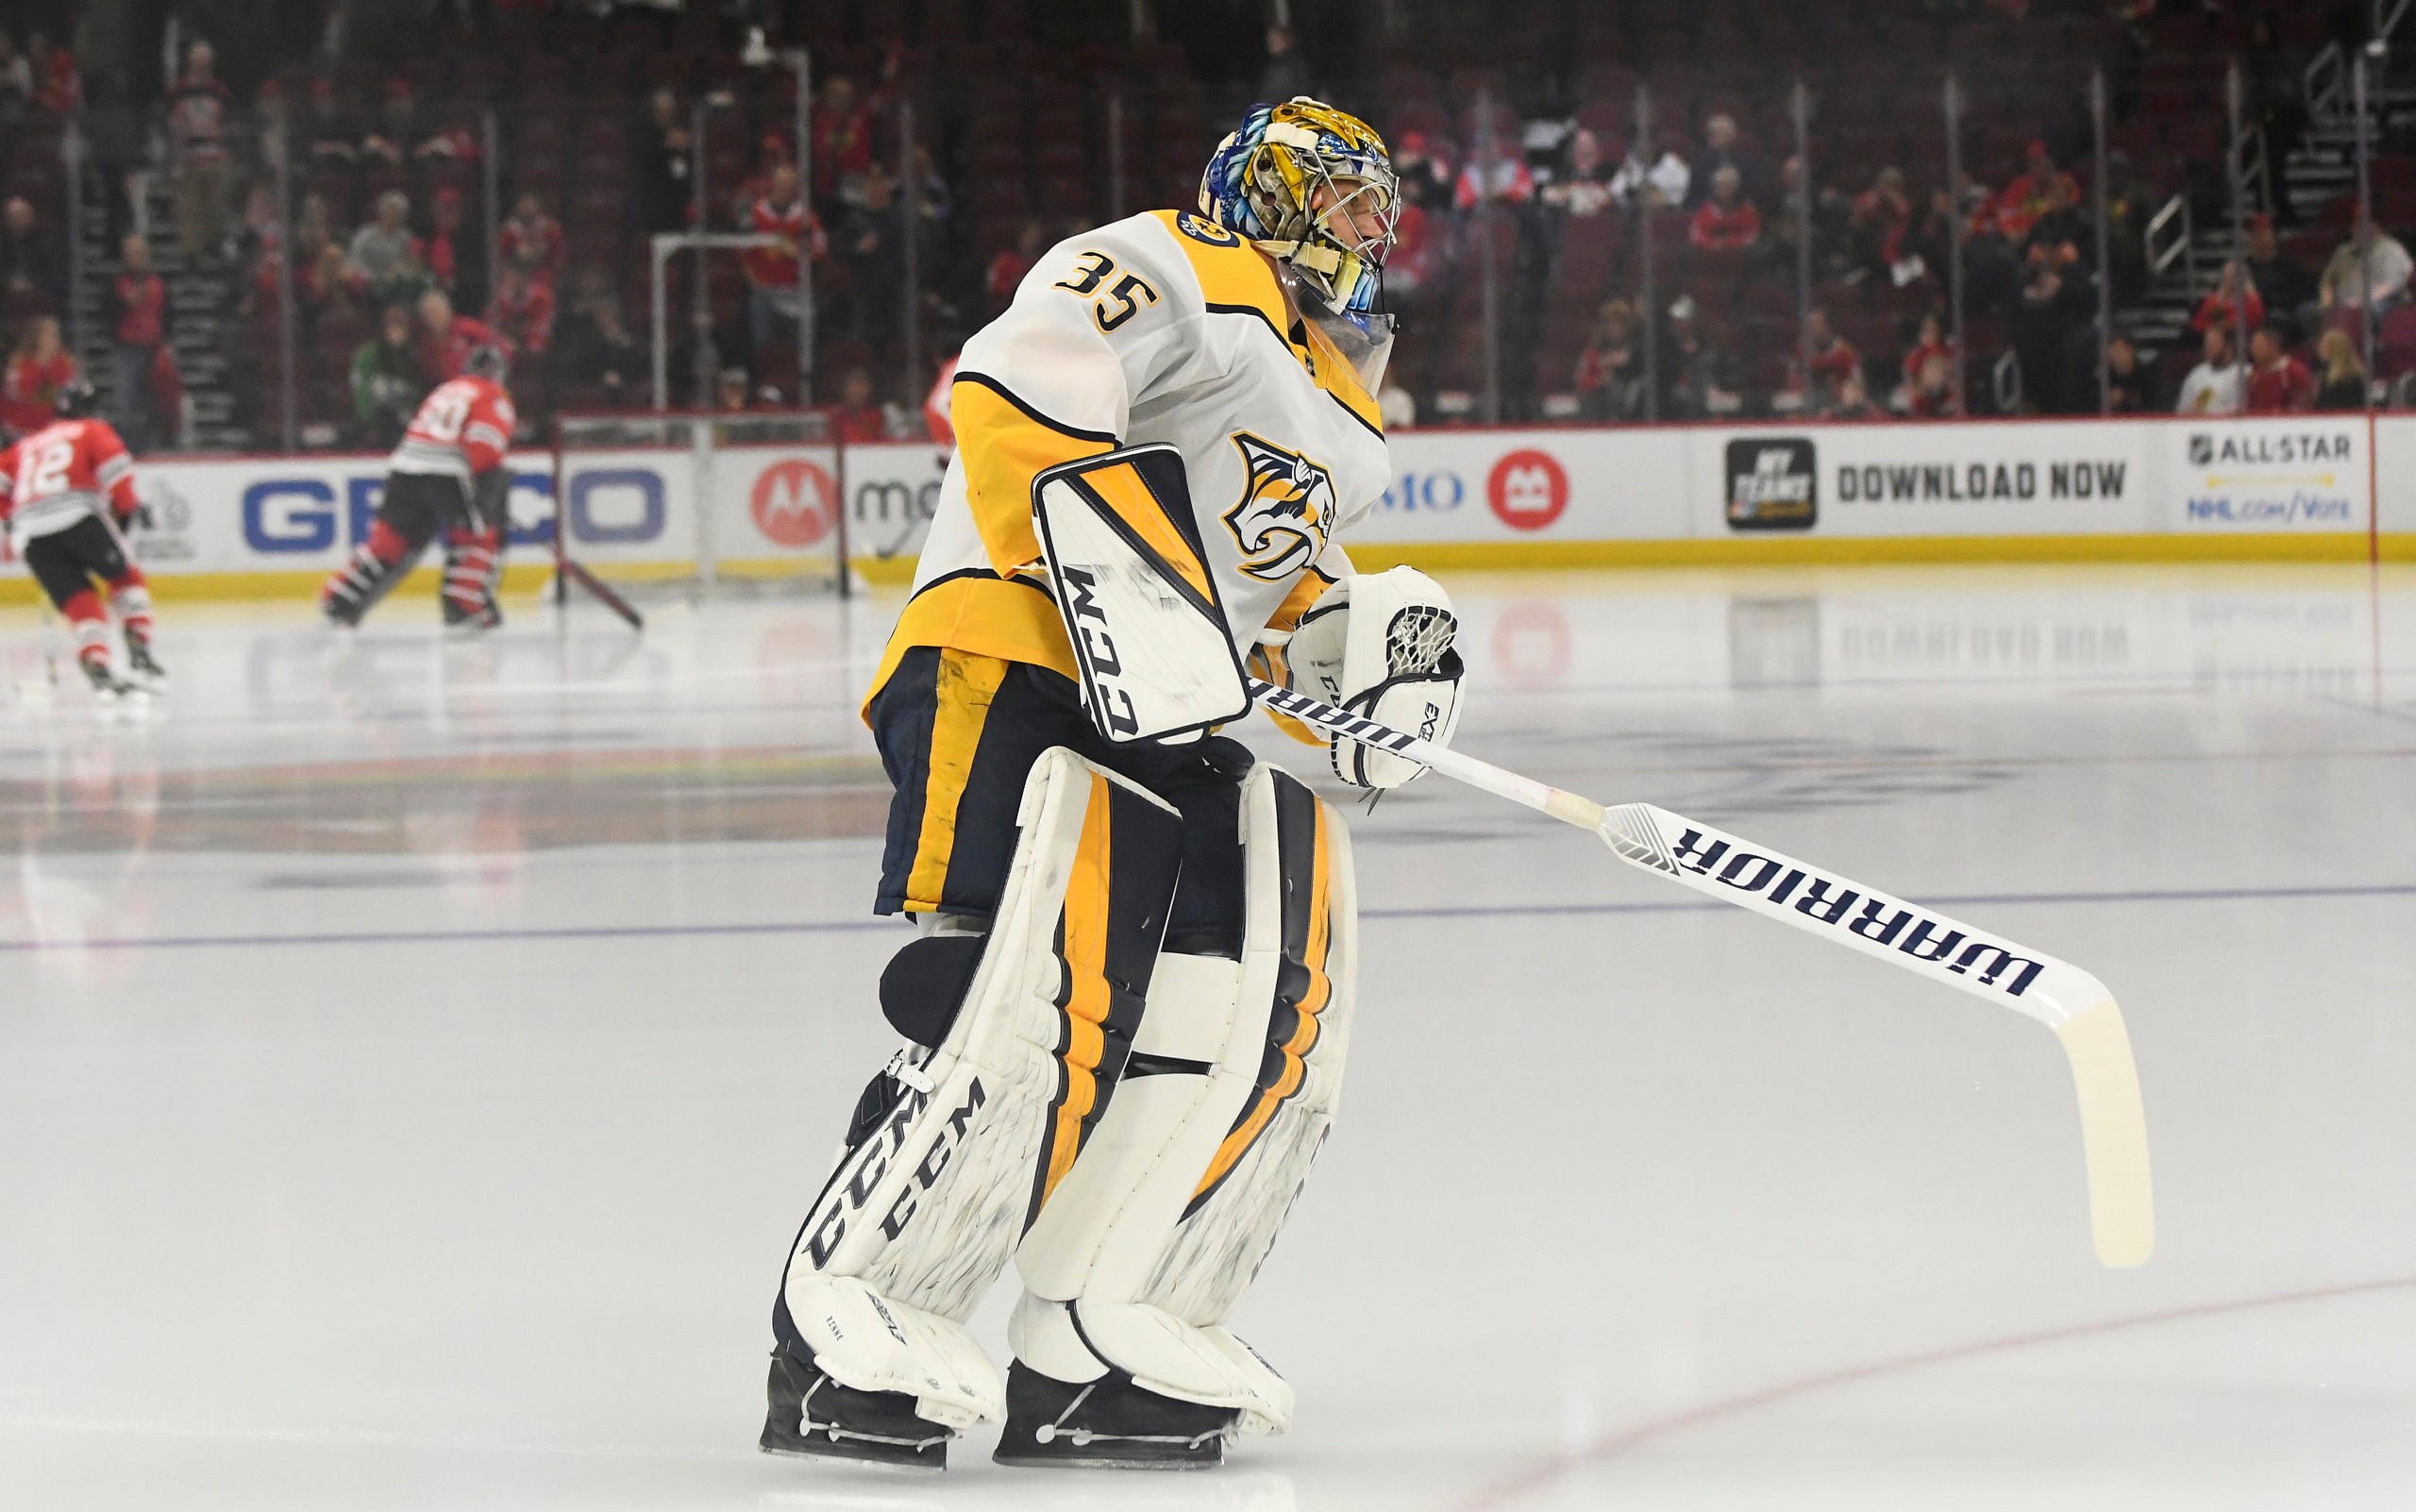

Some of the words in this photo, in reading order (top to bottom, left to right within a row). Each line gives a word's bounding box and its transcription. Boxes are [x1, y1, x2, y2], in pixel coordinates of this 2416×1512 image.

[1051, 248, 1162, 335] 35
[243, 470, 666, 553] GCO
[1837, 462, 2035, 502] DOWNLOAD
[2050, 460, 2127, 500] NOW
[1063, 564, 1138, 737] CCM
[1672, 828, 2045, 997] WARRIOR
[801, 1085, 928, 1270] CCM
[878, 1076, 986, 1241] CCM
[826, 1316, 844, 1341] RINNE
